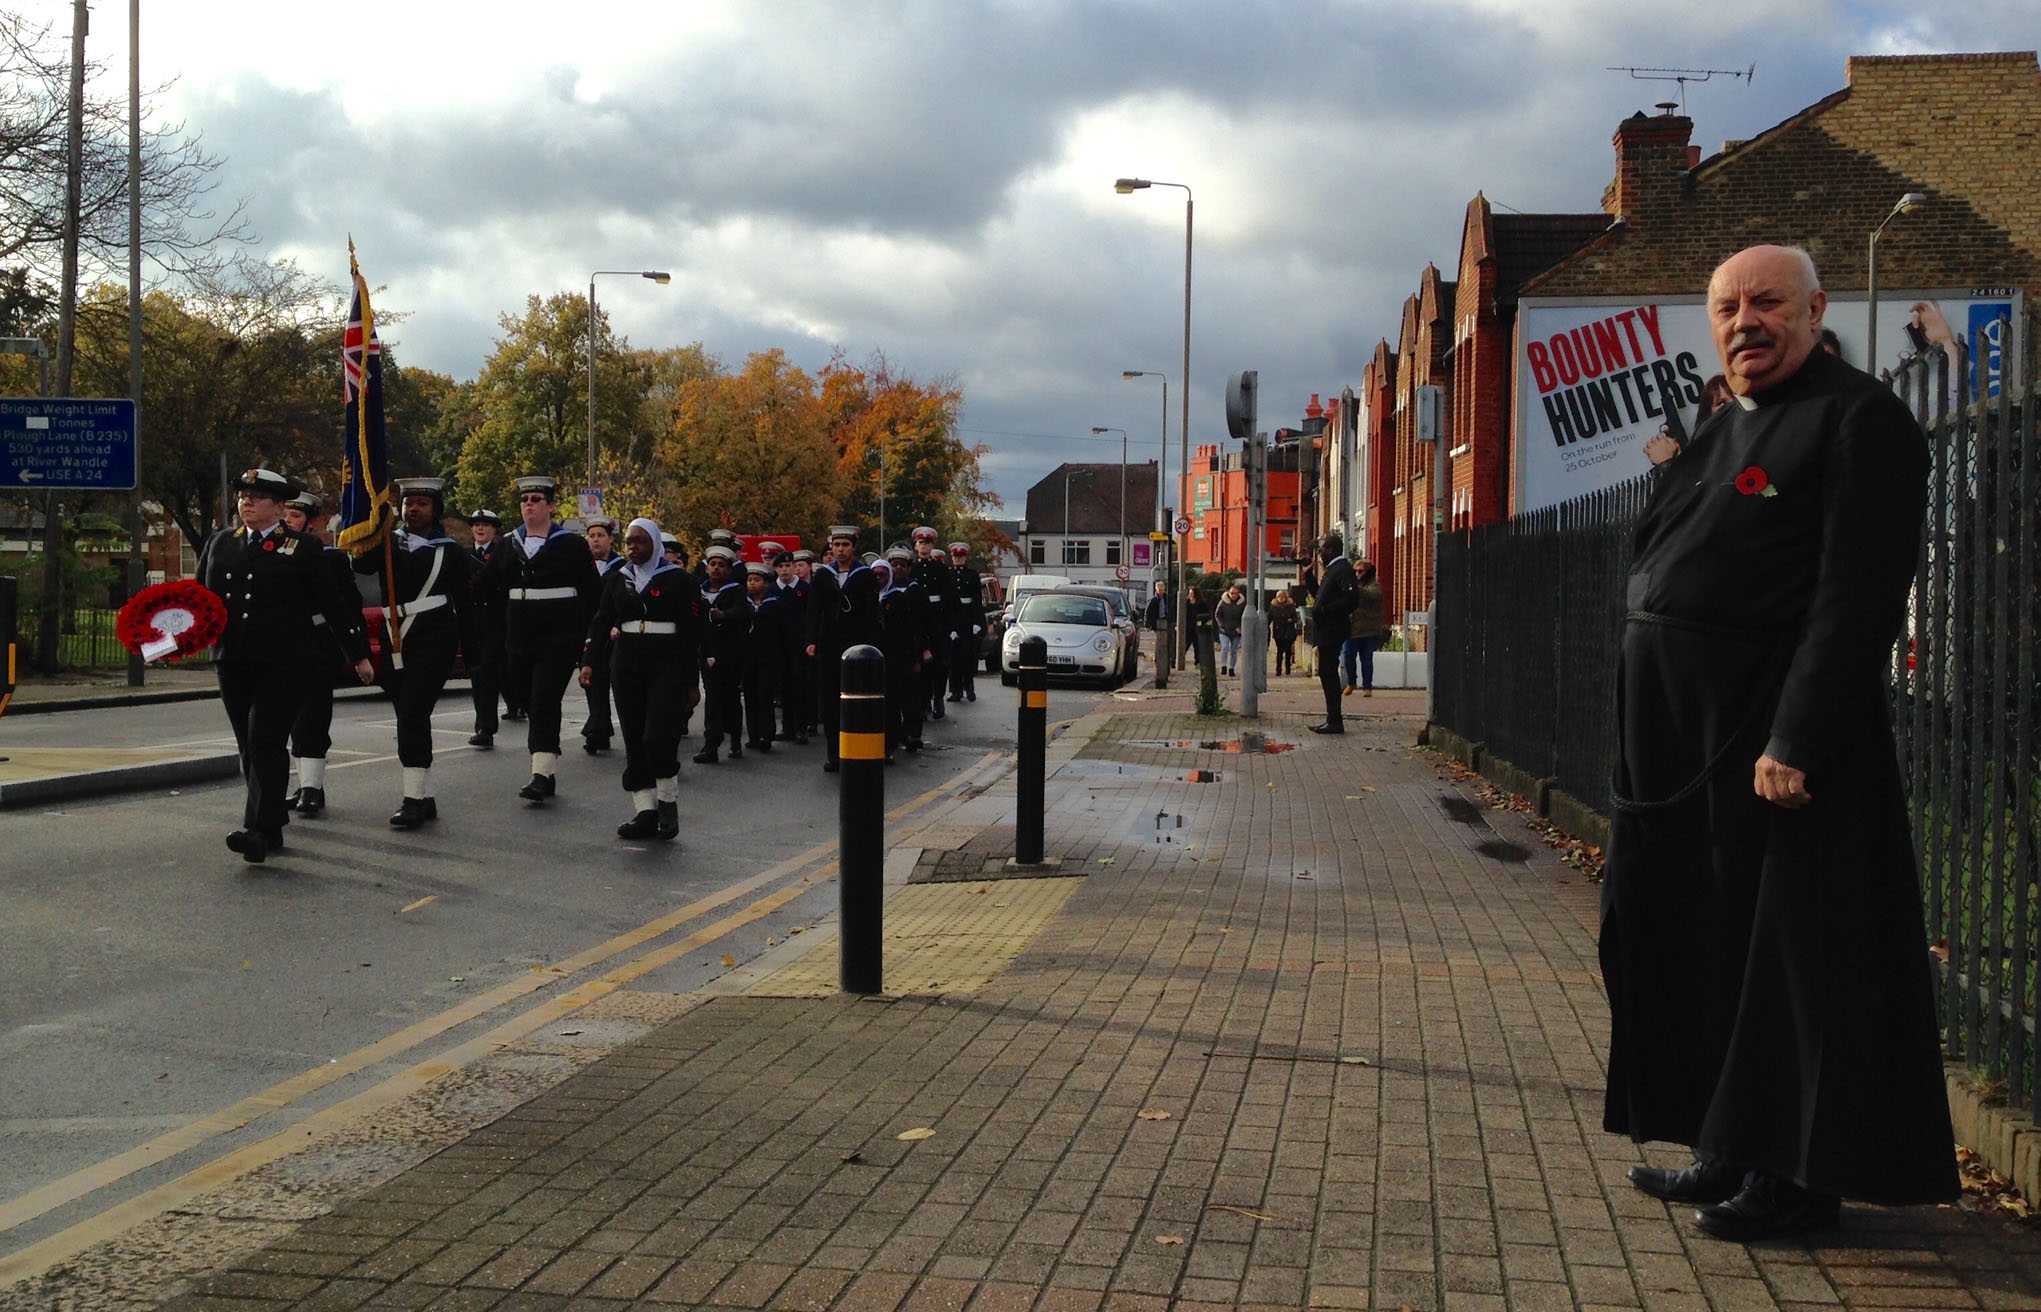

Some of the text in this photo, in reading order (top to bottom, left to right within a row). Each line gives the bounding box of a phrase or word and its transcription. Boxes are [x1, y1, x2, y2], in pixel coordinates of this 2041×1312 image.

[1527, 304, 1666, 395] BOUNTY
[1542, 351, 1704, 447] HUNTERS
[1, 403, 117, 416] Bridge Weight Limit
[51, 417, 95, 428] Tonnes
[3, 430, 45, 442] Plough
[48, 431, 77, 441] Lane
[8, 443, 111, 456] 530 yards ahead
[1561, 432, 1636, 461] On the run from
[11, 456, 108, 467] at River Wandle
[1565, 451, 1618, 472] 25 October
[46, 470, 71, 480] USE
